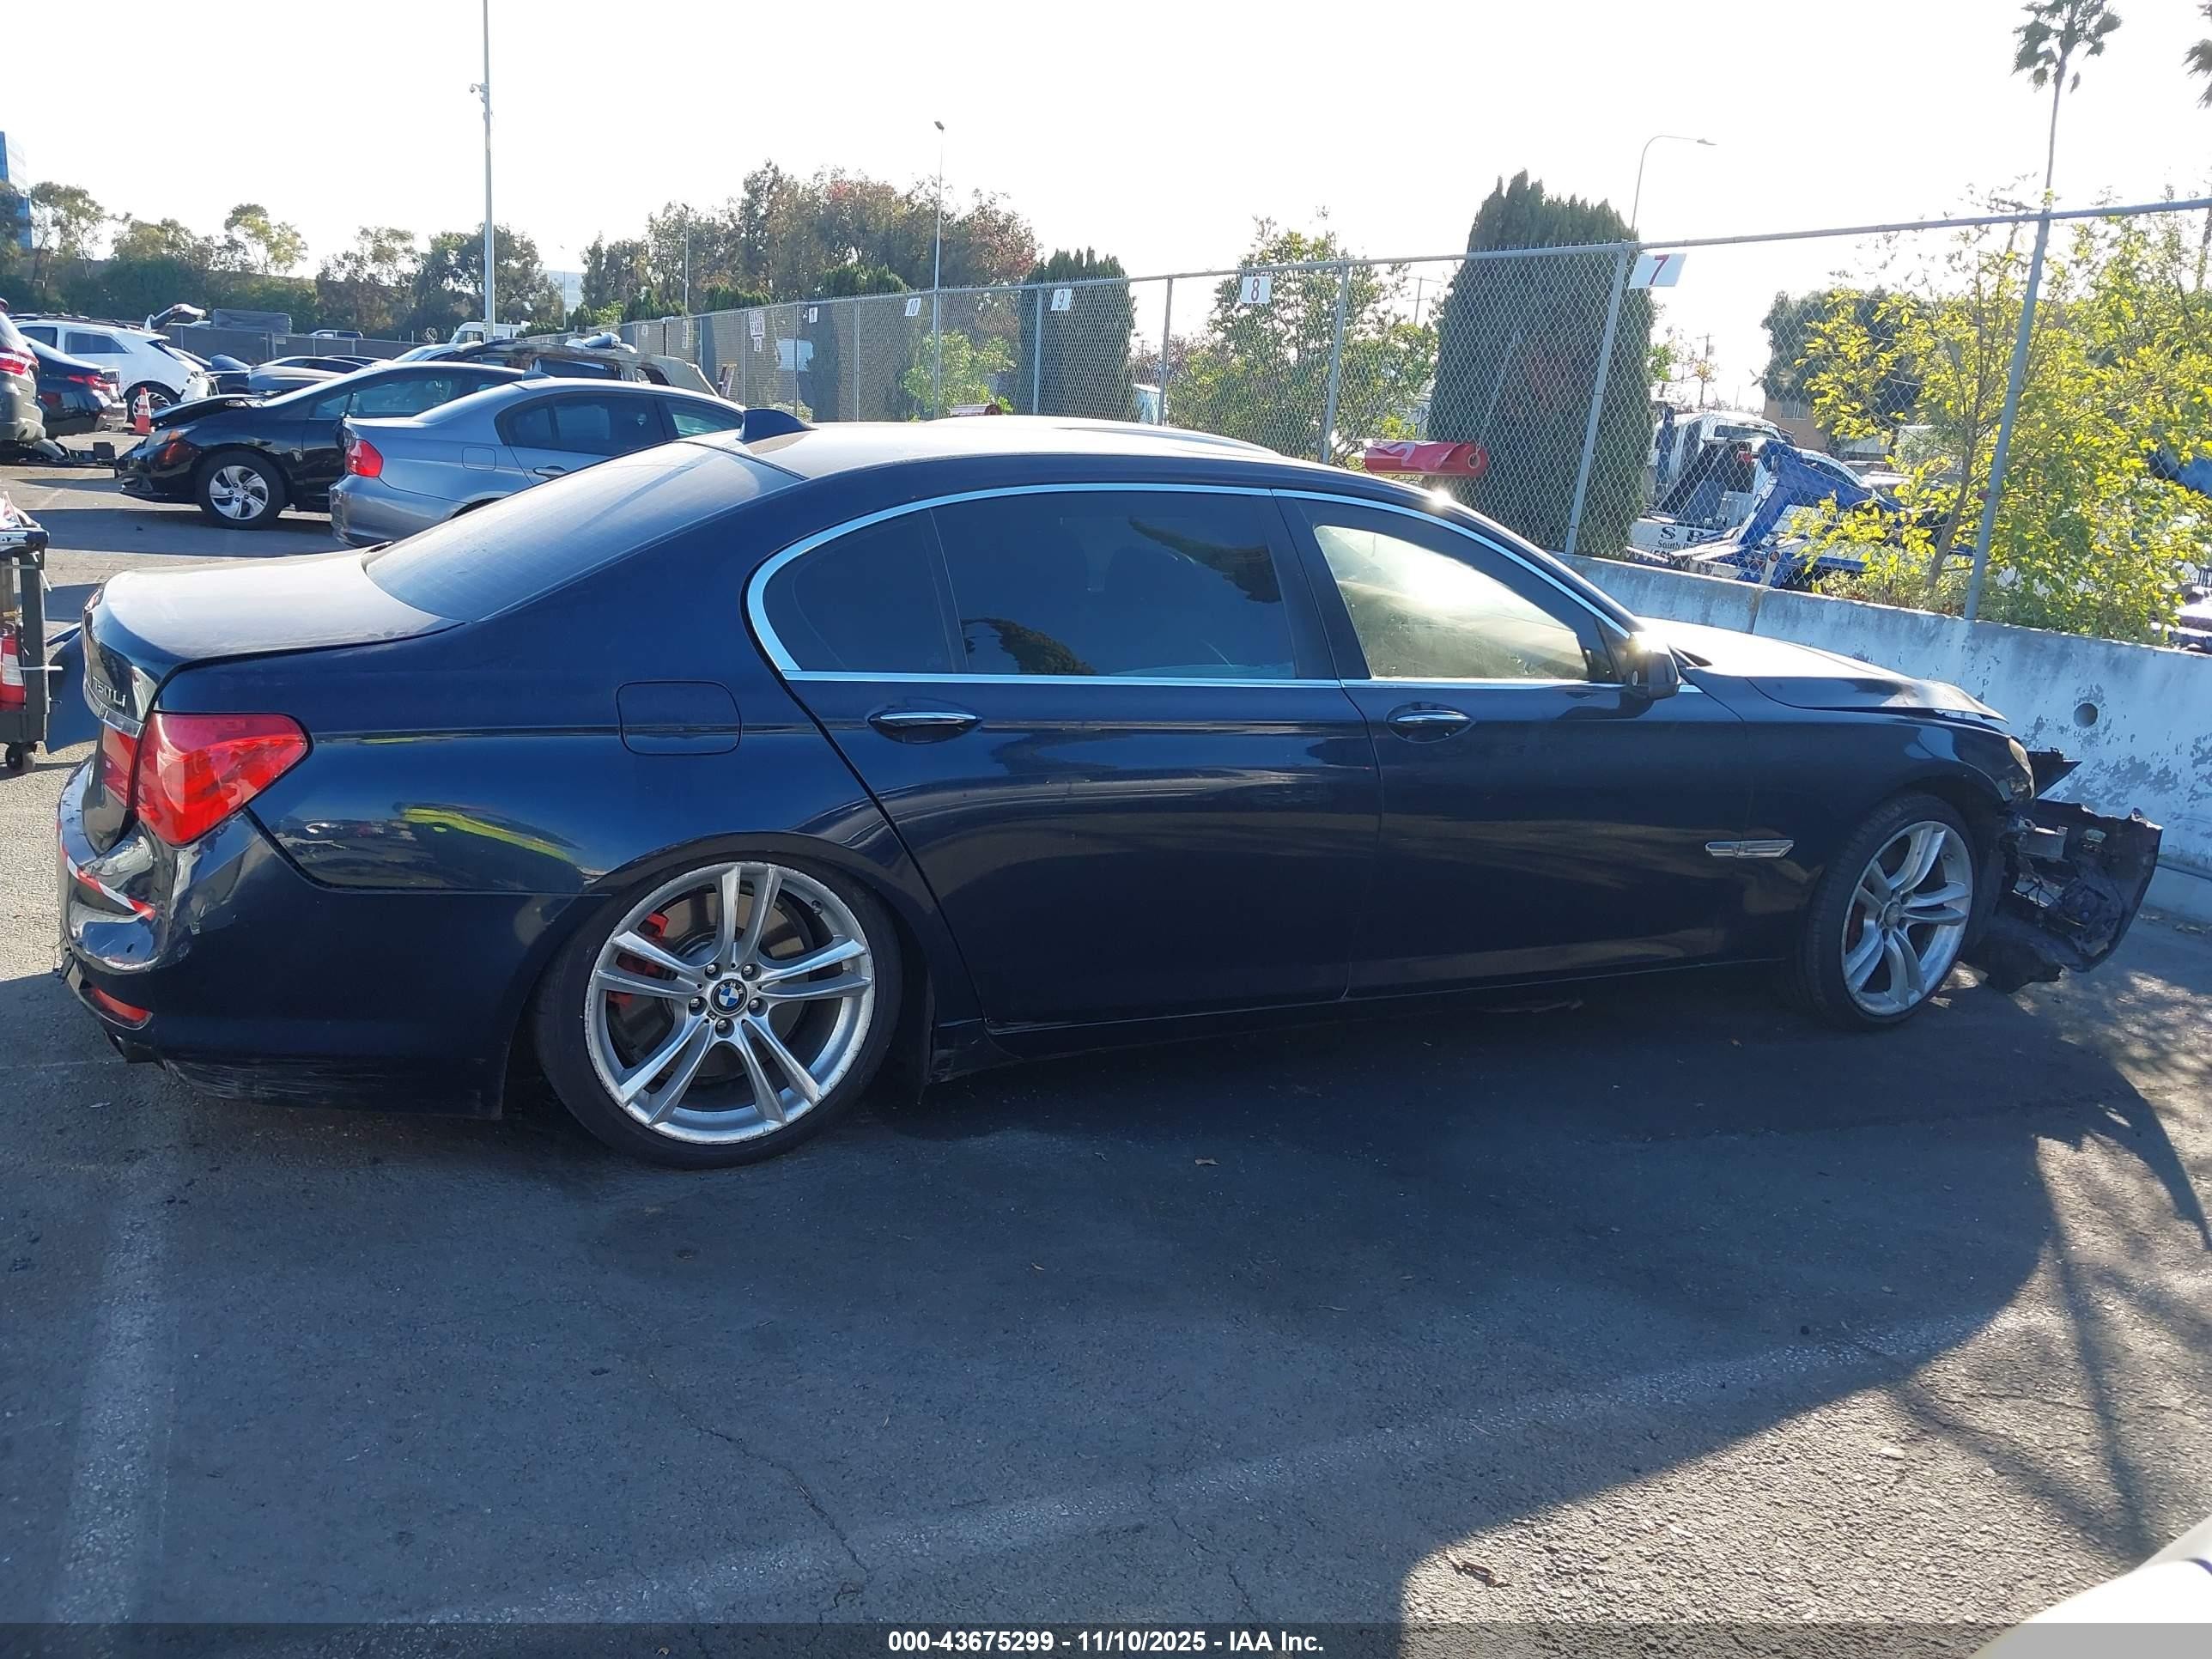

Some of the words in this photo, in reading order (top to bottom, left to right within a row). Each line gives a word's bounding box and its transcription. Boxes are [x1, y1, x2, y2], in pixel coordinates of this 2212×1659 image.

[1649, 254, 1670, 285] 7
[1250, 277, 1260, 302] 8
[908, 299, 919, 315] 10
[1057, 290, 1066, 309] 9
[1660, 526, 1676, 540] S
[720, 981, 744, 995] BMW
